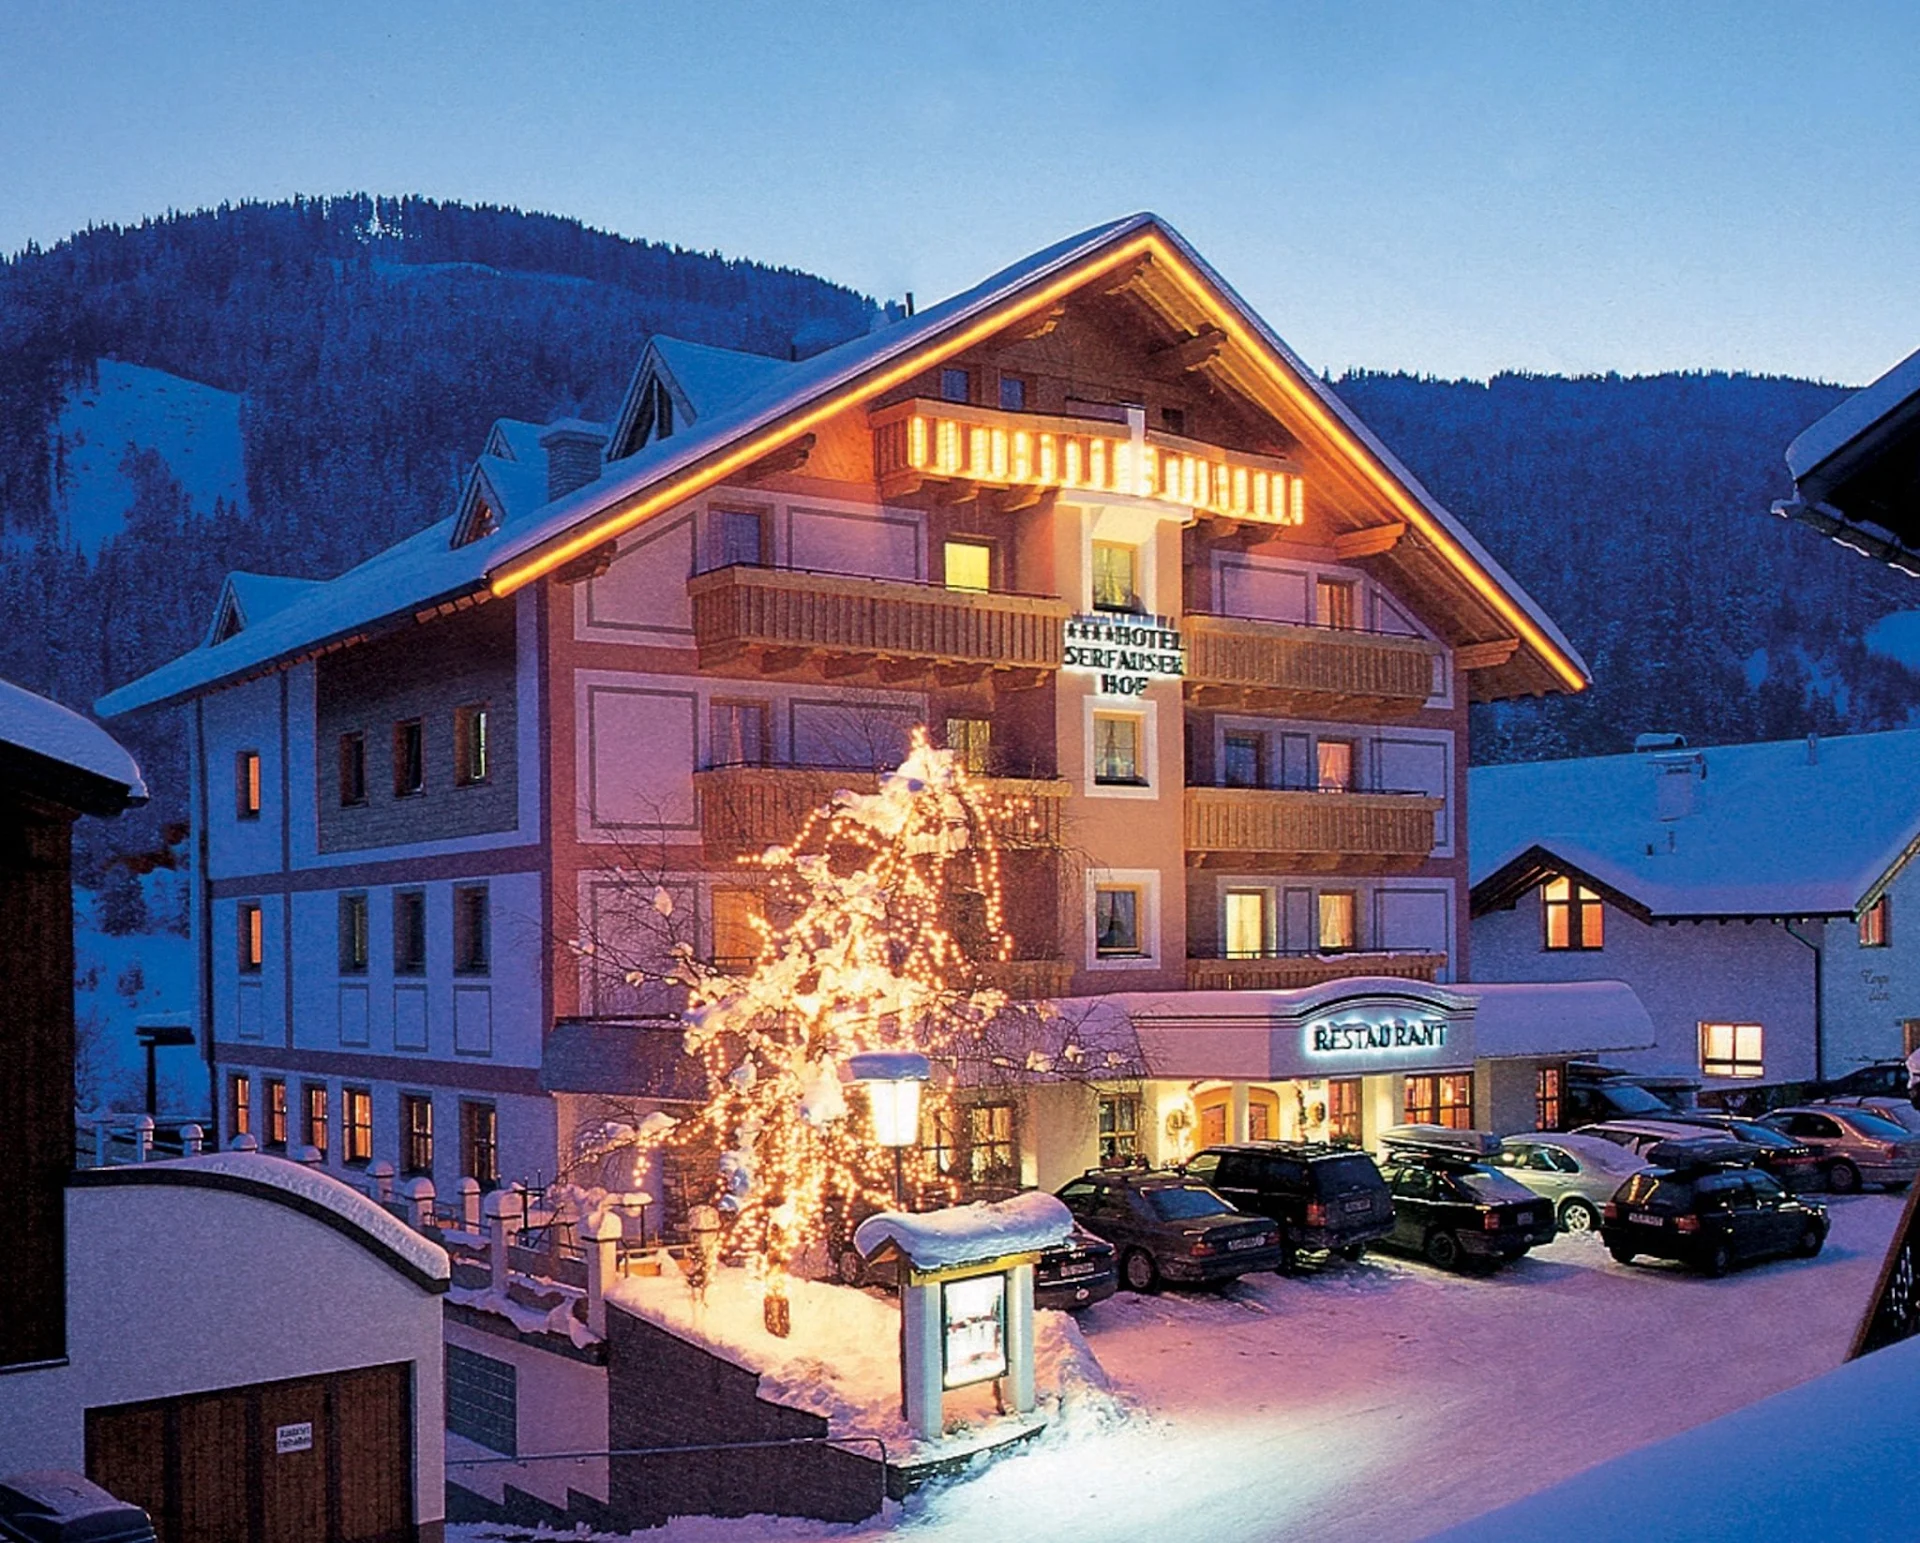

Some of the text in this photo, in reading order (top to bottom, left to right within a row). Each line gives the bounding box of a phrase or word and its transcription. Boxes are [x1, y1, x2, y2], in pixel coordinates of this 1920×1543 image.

[1115, 626, 1187, 650] HOTEL
[1101, 674, 1149, 696] HOF
[1314, 1024, 1448, 1051] RESTAURANT
